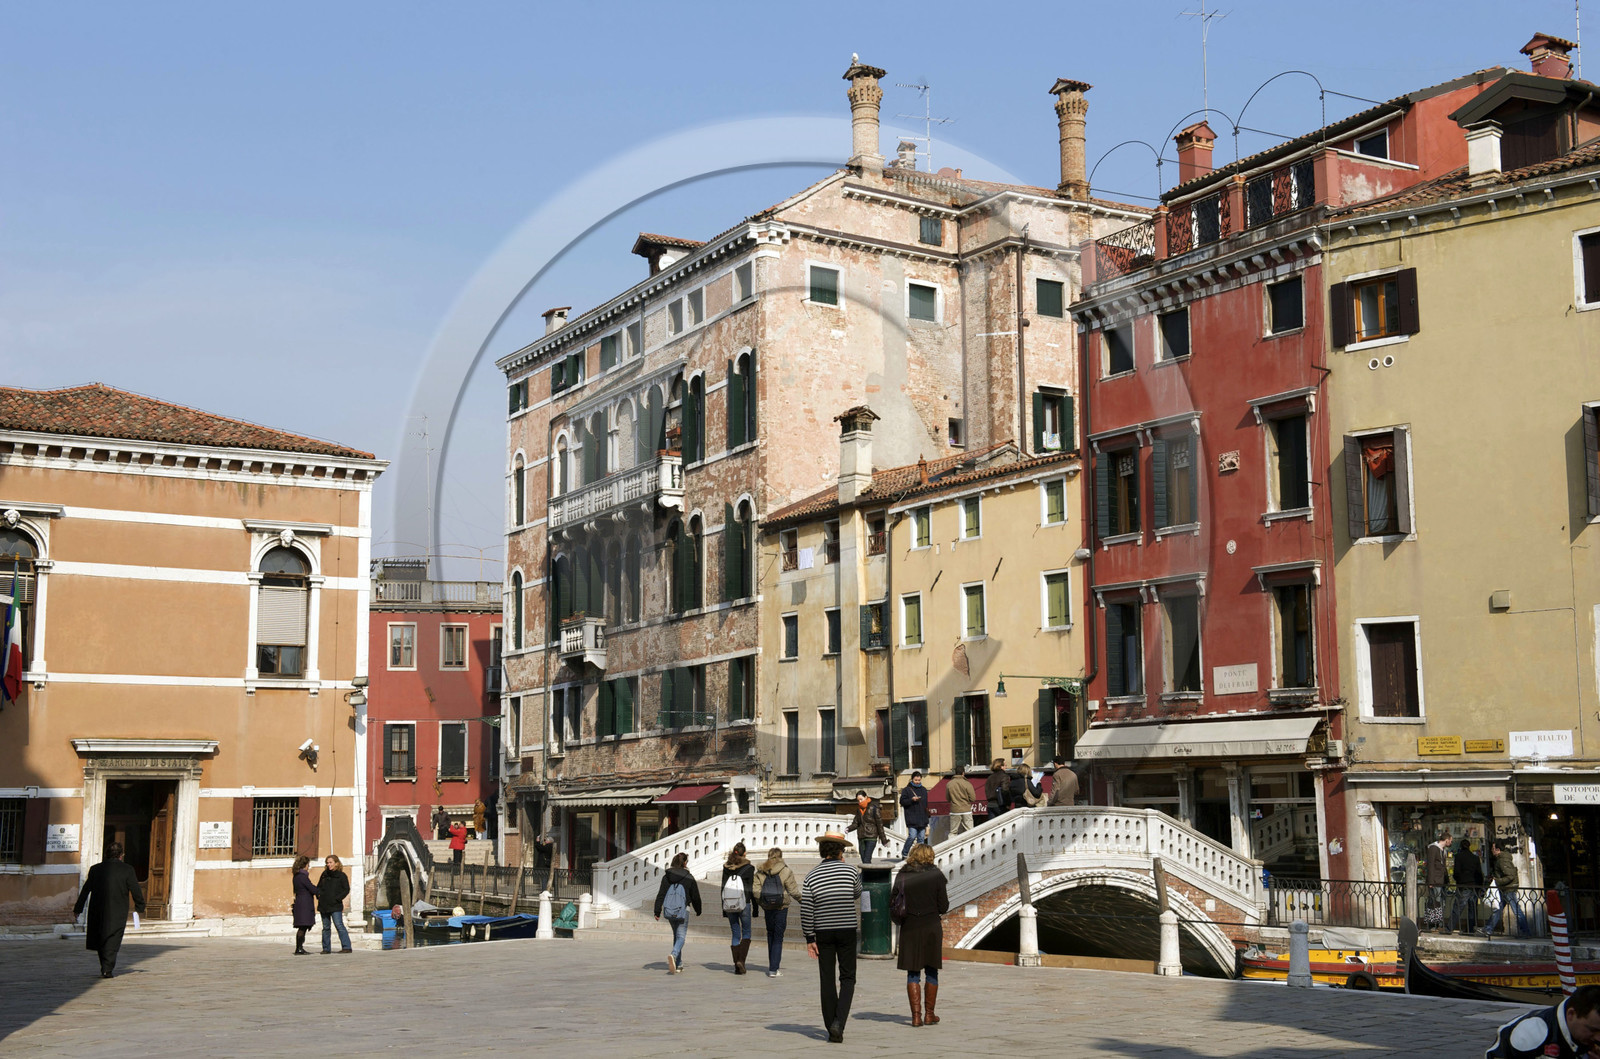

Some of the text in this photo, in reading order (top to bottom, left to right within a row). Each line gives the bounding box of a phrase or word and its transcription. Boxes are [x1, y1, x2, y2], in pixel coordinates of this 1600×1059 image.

[1223, 669, 1247, 678] PONTE
[1537, 734, 1568, 742] RIALTO
[109, 758, 189, 767] ARCHIVIO DI STATO
